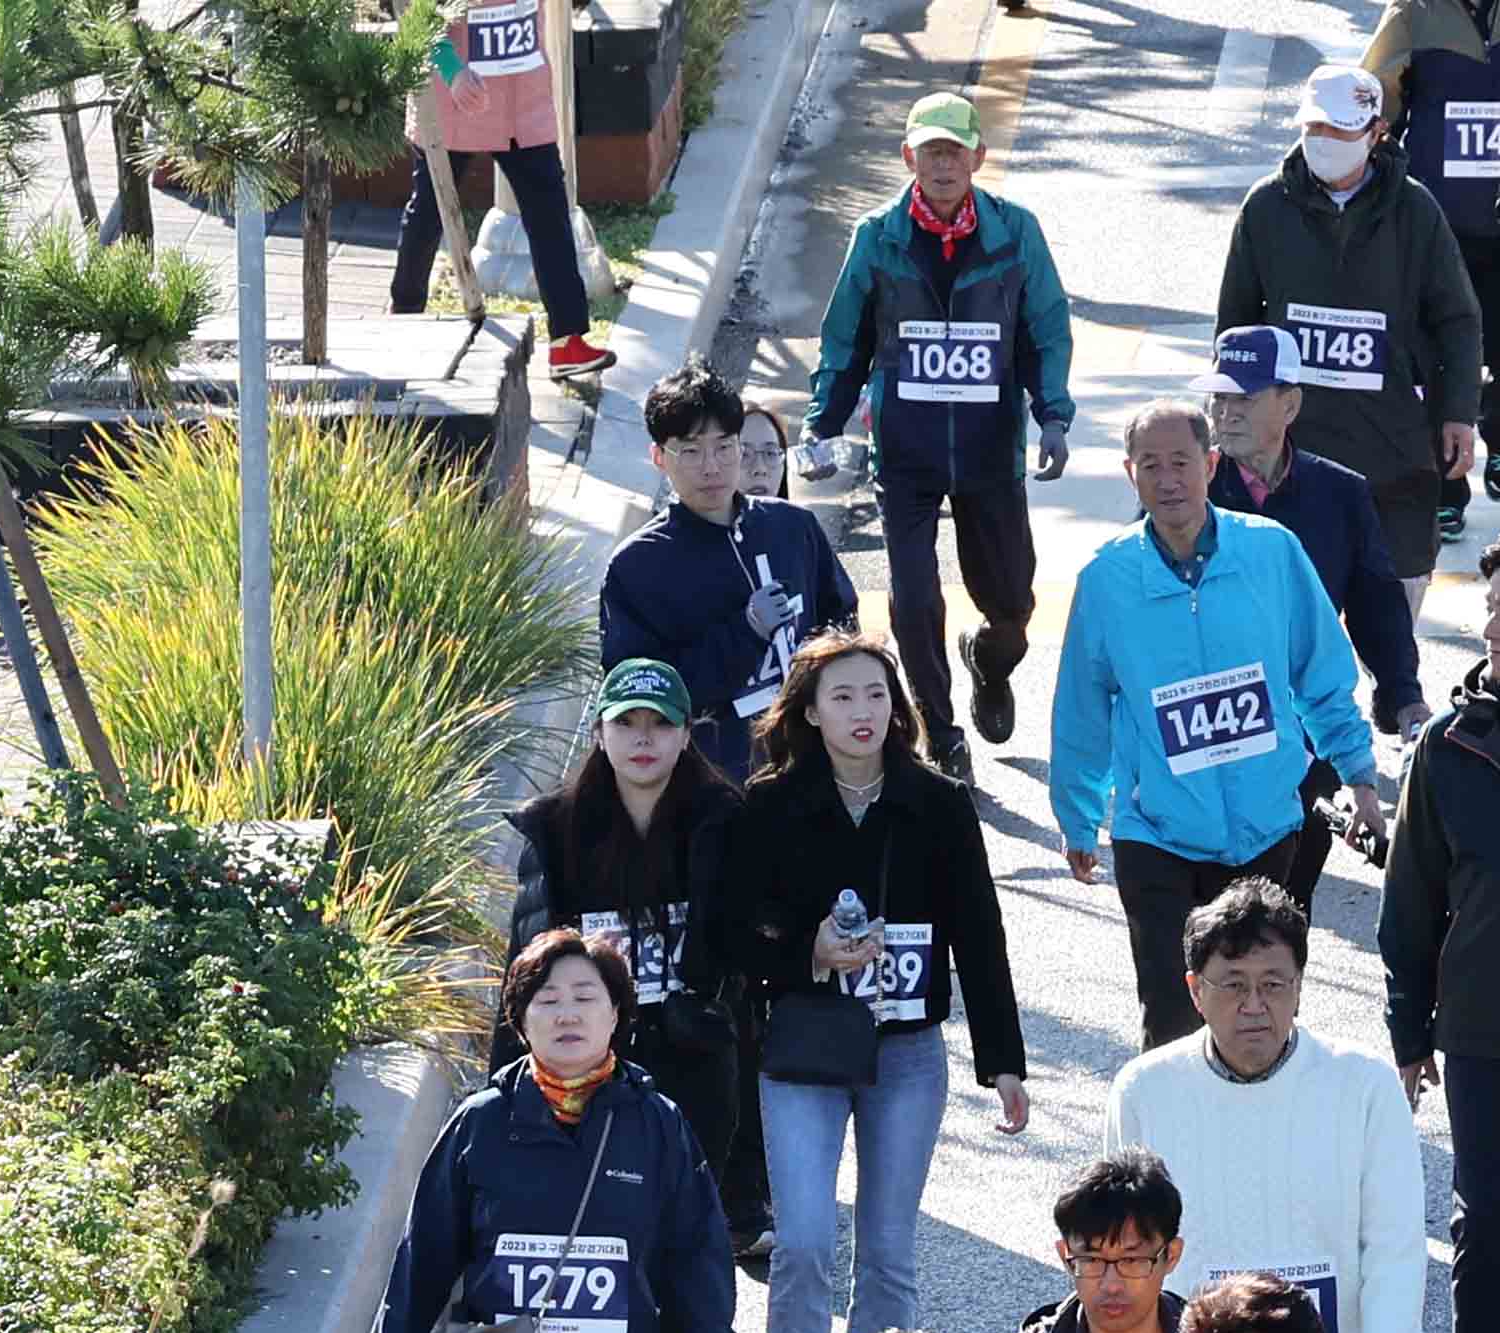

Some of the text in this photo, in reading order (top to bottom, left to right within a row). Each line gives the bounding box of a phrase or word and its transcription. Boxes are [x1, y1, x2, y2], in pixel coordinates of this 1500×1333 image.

[478, 19, 536, 56] 1123
[908, 343, 992, 380] 1068
[1298, 327, 1375, 368] 1148
[1166, 691, 1266, 747] 1442
[501, 1240, 527, 1252] 2023
[507, 1263, 617, 1312] 1279
